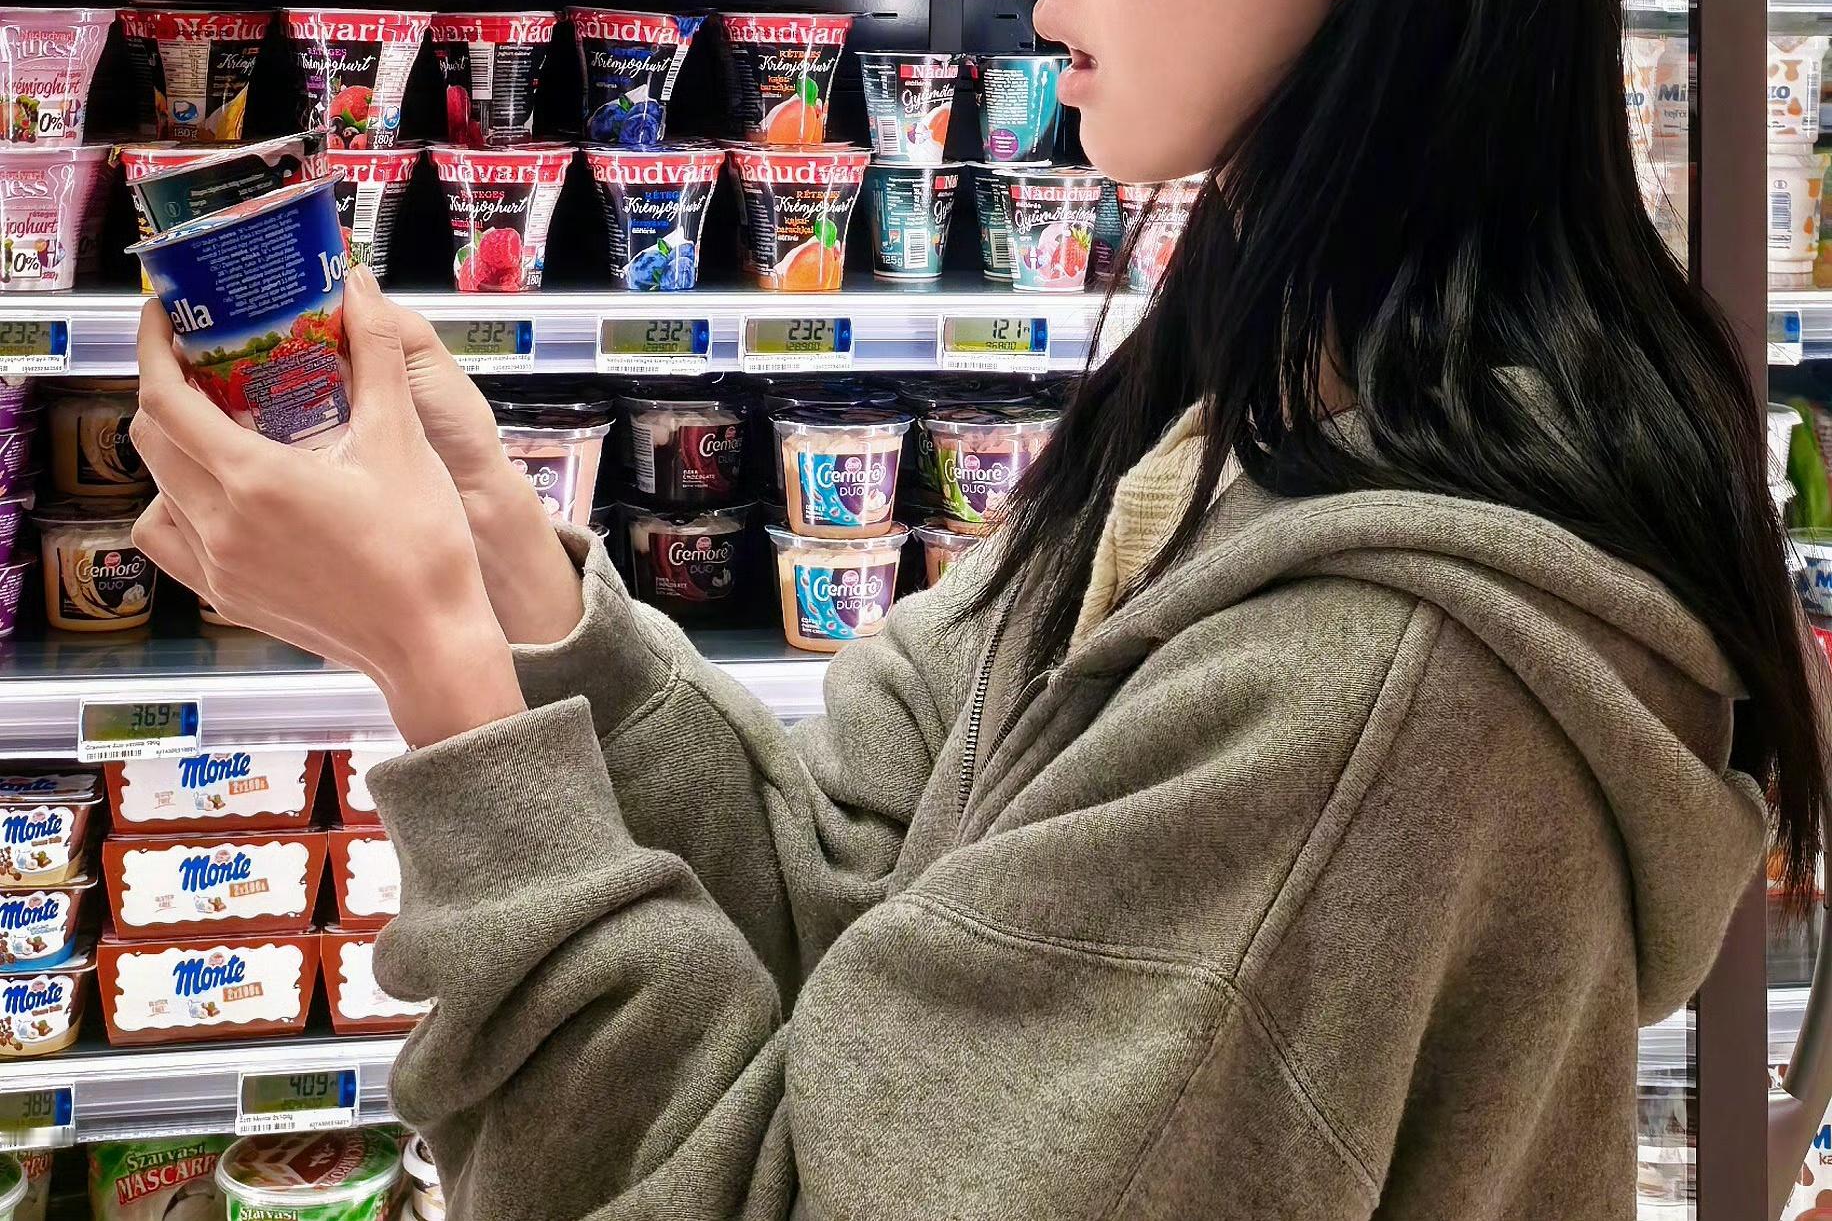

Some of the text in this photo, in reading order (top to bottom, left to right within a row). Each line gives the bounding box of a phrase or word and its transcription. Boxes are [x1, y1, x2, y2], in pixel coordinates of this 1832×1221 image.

[288, 15, 386, 42] udvari
[780, 49, 821, 59] RÉTEES
[1659, 84, 1687, 102] Mi
[40, 112, 62, 133] 0%
[438, 159, 542, 184] udvari
[2, 179, 49, 198] ness
[5, 218, 59, 239] joghurt
[13, 253, 40, 273] 0%
[467, 321, 507, 343] 232
[646, 320, 684, 342] 232
[788, 319, 826, 341] 232
[992, 319, 1022, 340] 121
[839, 486, 865, 497] DUO
[962, 484, 986, 494] DUO
[836, 599, 863, 610] DUO
[131, 704, 170, 728] 369
[179, 752, 251, 790] Monte
[2, 812, 63, 845] Monte
[179, 851, 252, 892] Monte
[0, 898, 60, 930] Monte
[173, 954, 246, 997] Monte
[2, 982, 63, 1016] Monte
[290, 1074, 328, 1097] 409
[22, 1091, 52, 1118] 389
